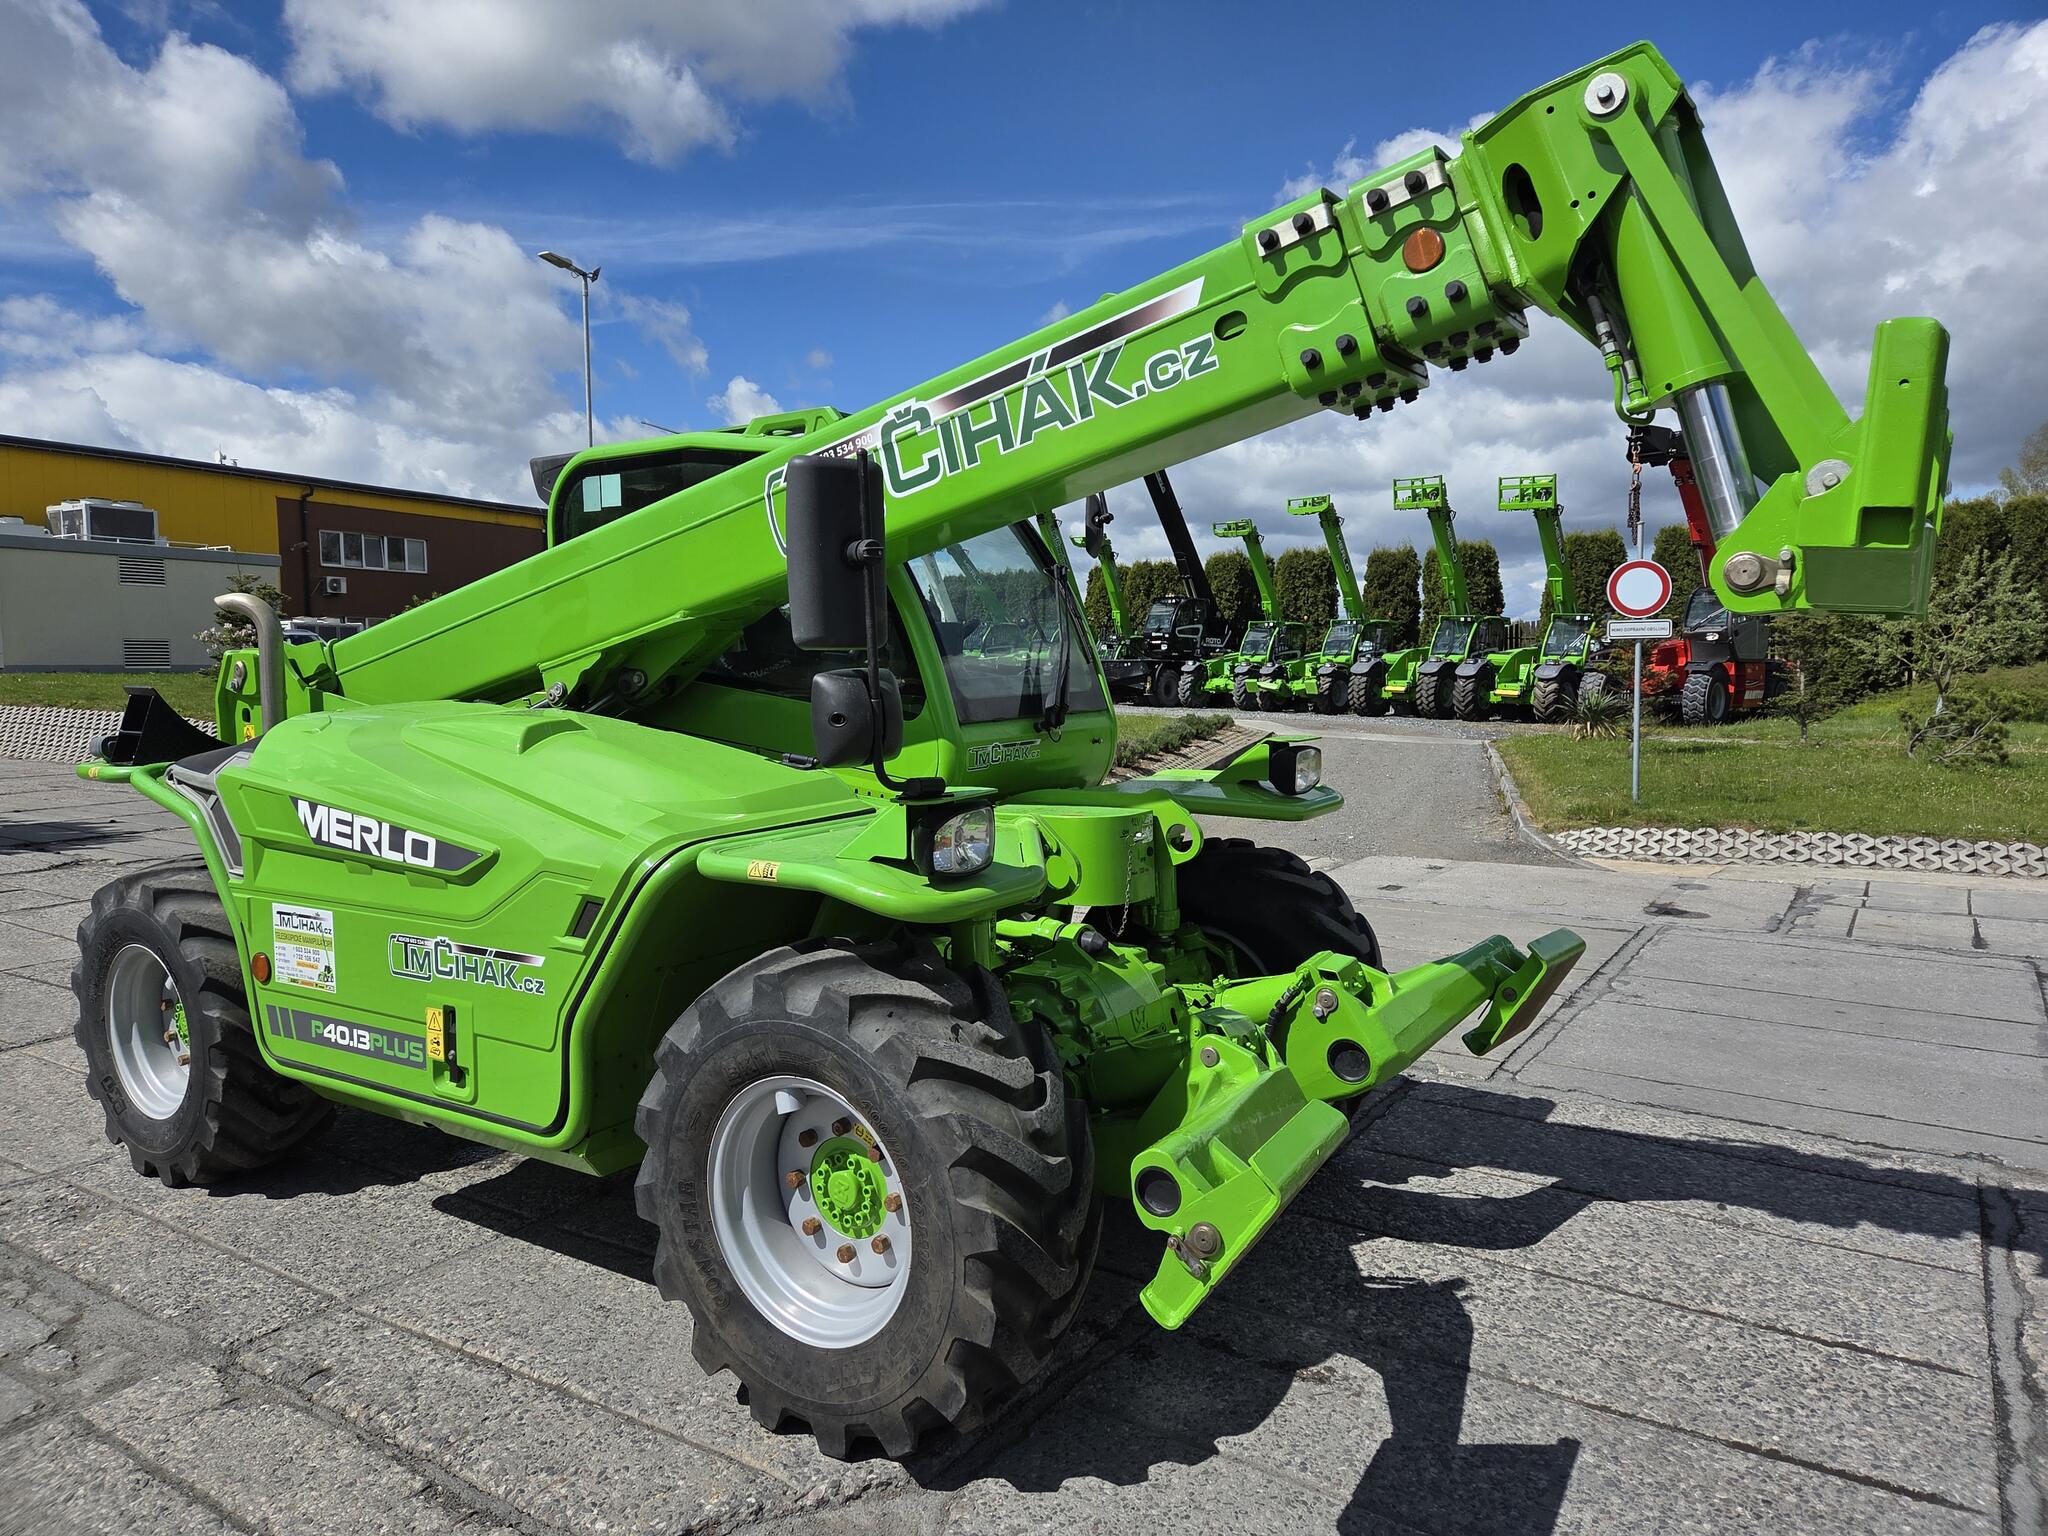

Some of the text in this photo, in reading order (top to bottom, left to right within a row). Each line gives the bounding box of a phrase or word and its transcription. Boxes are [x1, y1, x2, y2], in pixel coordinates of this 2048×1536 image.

[836, 441, 854, 457] 534
[855, 433, 873, 449] 900
[1205, 637, 1222, 645] ROTO
[297, 799, 437, 868] MERLO
